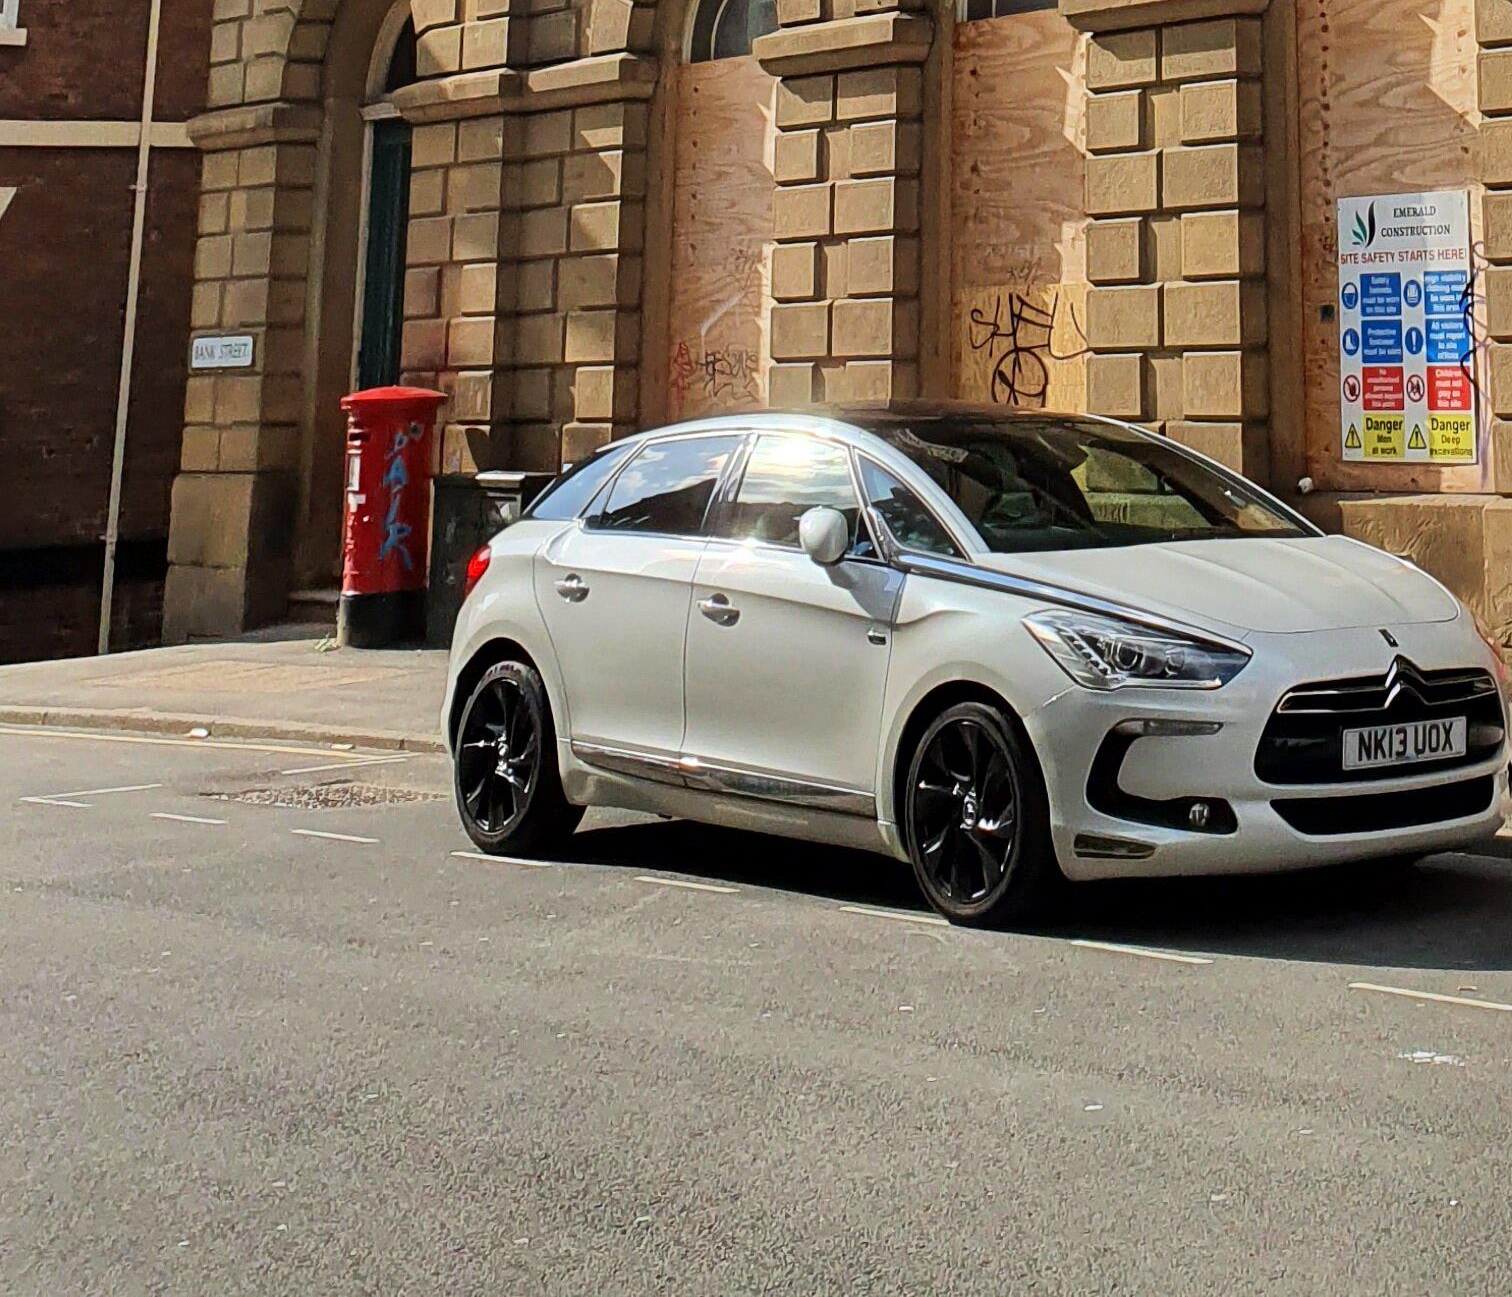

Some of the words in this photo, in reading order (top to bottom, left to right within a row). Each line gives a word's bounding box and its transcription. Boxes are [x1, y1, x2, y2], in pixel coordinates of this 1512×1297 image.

[1393, 205, 1437, 219] EMERALD
[1380, 223, 1451, 238] CONSTRUCTION
[1341, 252, 1359, 265] SITE
[1361, 251, 1395, 264] SAFETY
[1398, 249, 1435, 263] STARTS
[1365, 417, 1403, 434] Danger
[1431, 417, 1471, 434] Danger
[1441, 435, 1461, 446] Deep
[1380, 446, 1397, 455] work
[1358, 726, 1408, 762] NK13
[1414, 721, 1454, 756] UOX
